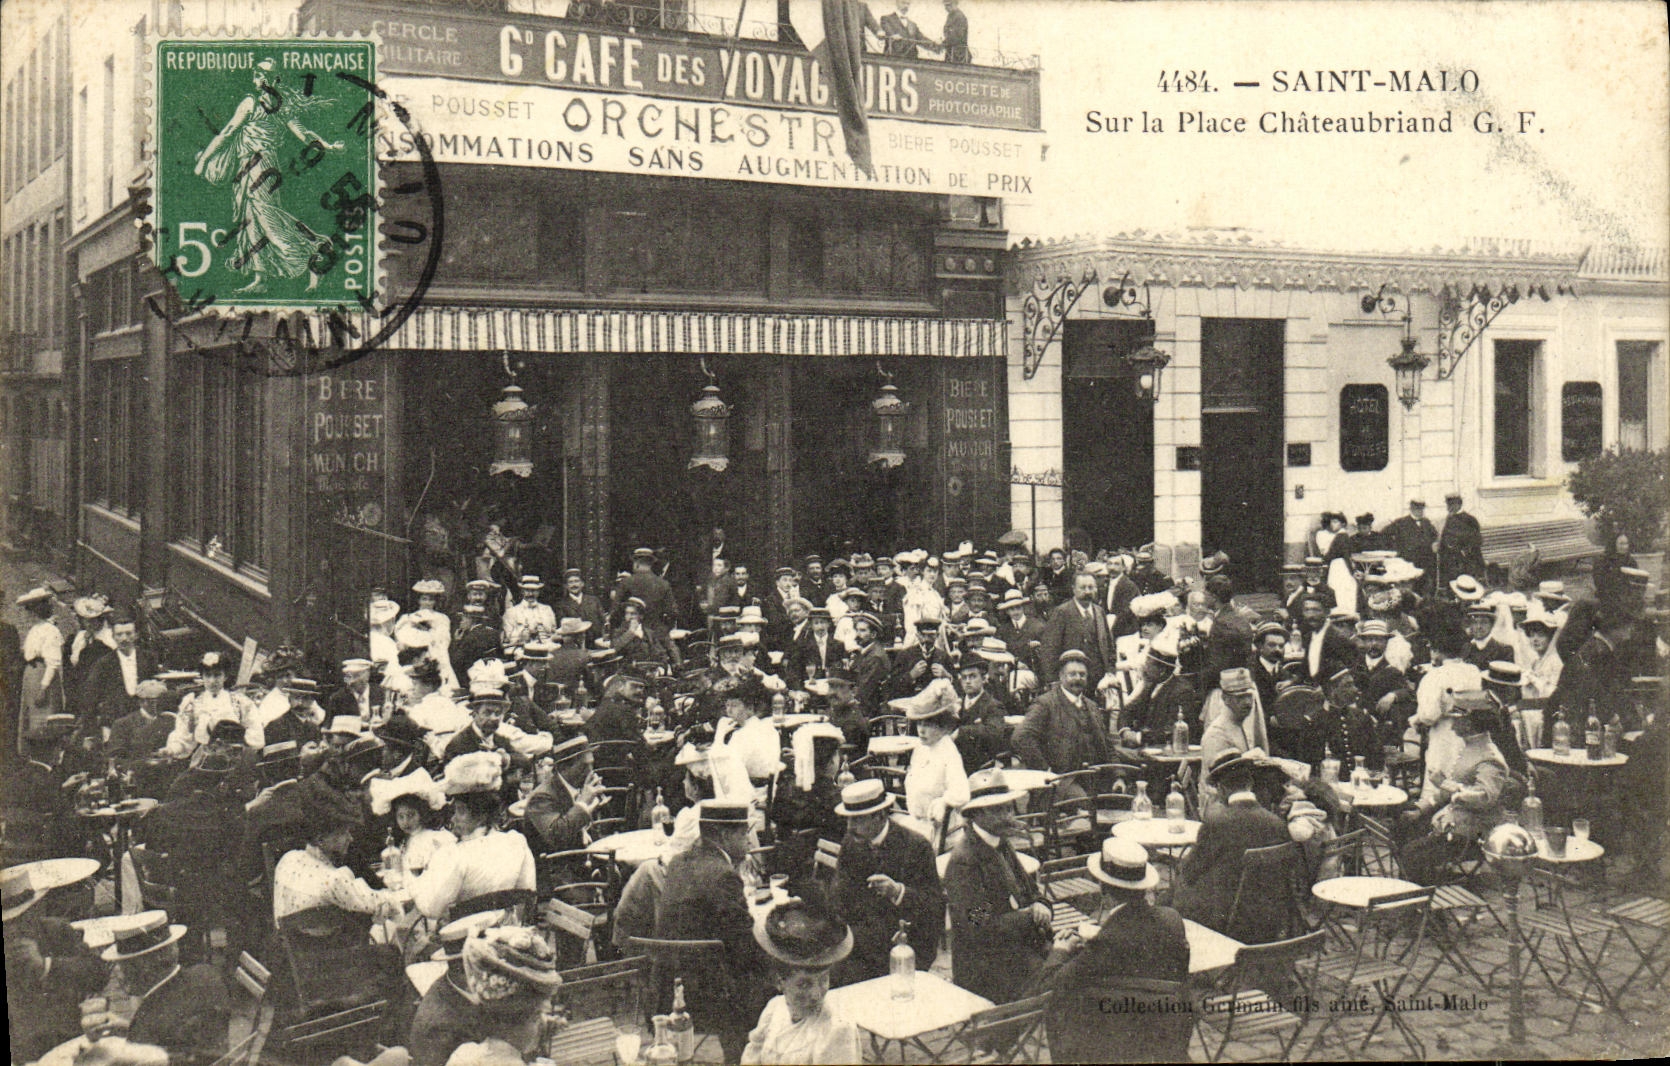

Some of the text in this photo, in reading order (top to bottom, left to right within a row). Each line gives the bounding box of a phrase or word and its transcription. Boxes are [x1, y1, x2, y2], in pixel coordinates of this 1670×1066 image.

[373, 20, 459, 43] CERCLE
[282, 51, 366, 72] FRANÇAISE
[657, 53, 706, 86] DES
[719, 49, 919, 115] VOYAGURS
[928, 99, 1022, 120] PHOTOGRAPHIE
[432, 94, 836, 157] POUSSET ORCHESTR
[888, 132, 1023, 158] BIERE POUSSET
[628, 146, 704, 172] SANS
[737, 153, 931, 186] AUGMENTATION
[948, 172, 969, 188] DE
[987, 172, 1033, 194] PRIX
[318, 375, 377, 401] BERE
[949, 378, 988, 398] BIEE
[313, 451, 378, 474] MUNCH
